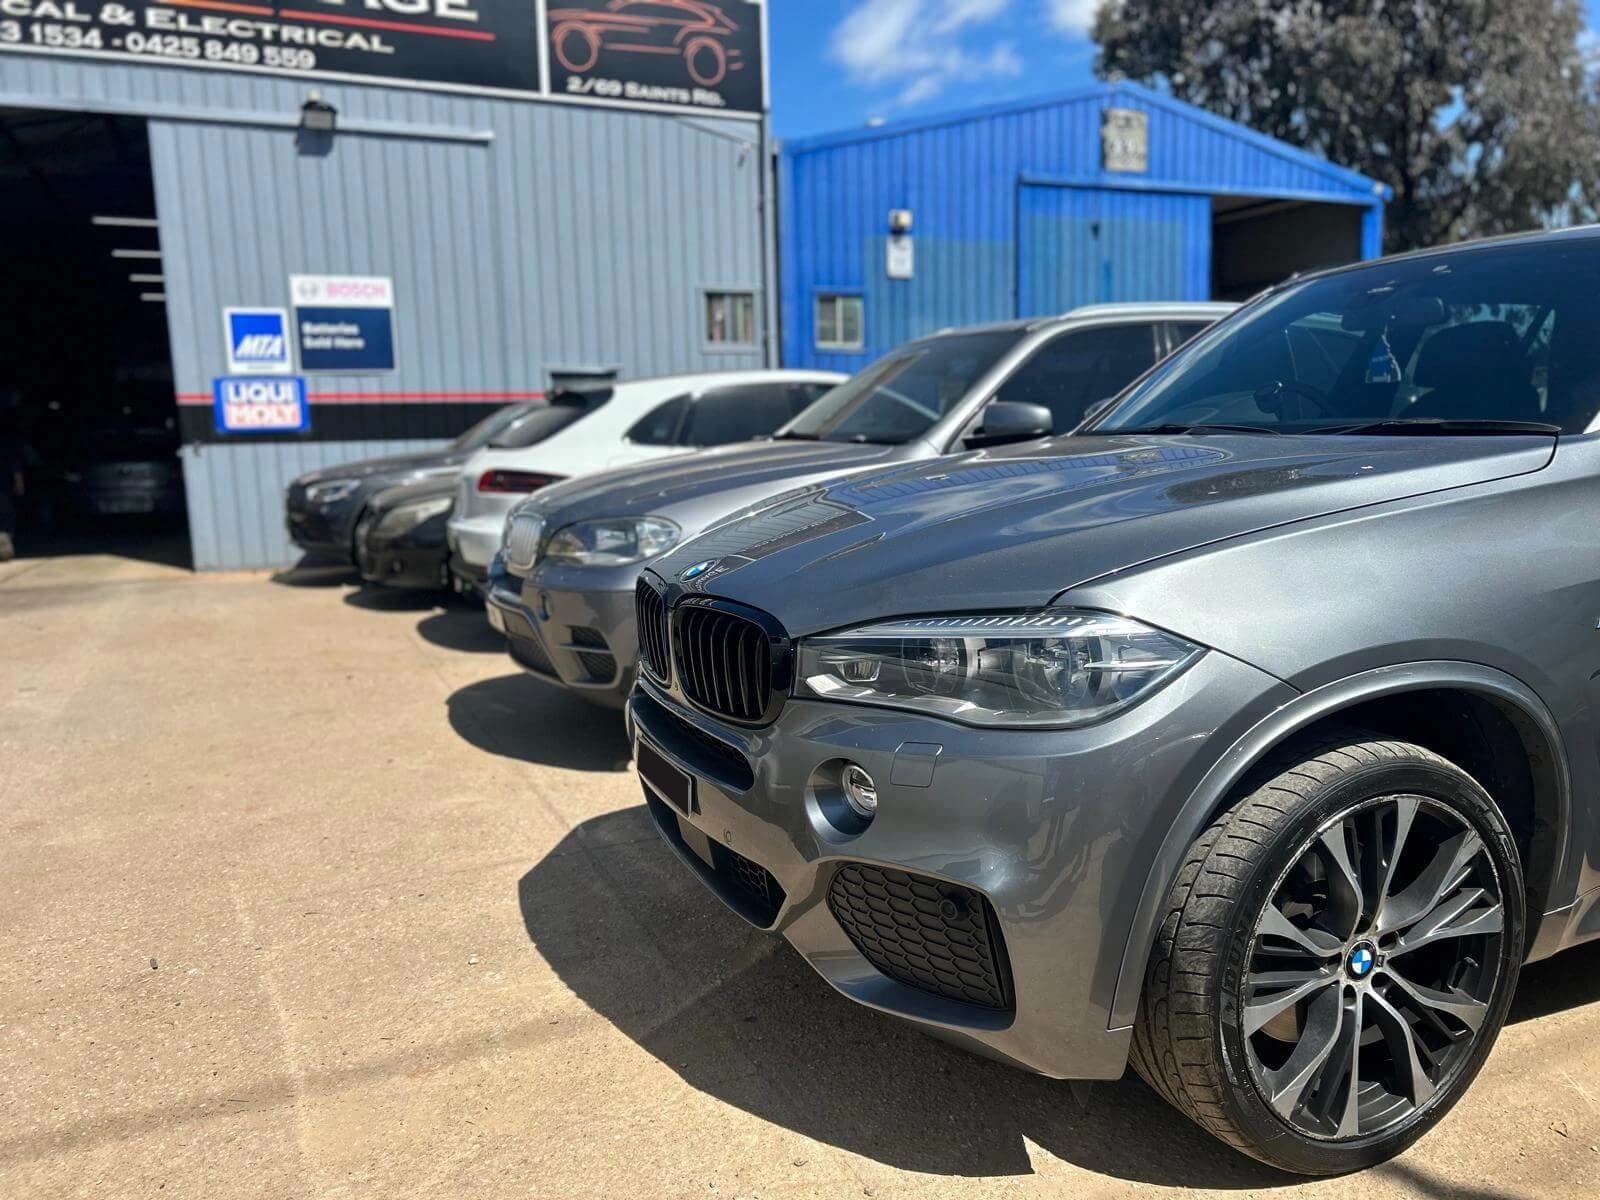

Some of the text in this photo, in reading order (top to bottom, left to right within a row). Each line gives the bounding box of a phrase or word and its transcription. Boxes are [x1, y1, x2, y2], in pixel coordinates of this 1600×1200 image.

[99, 3, 135, 26] &
[145, 7, 395, 54] ELECTRICAL
[30, 22, 103, 49] 1534
[204, 39, 259, 65] 849
[263, 46, 316, 70] 559
[235, 334, 284, 358] MTA
[227, 381, 295, 403] LIQUI
[227, 403, 300, 428] MOLY
